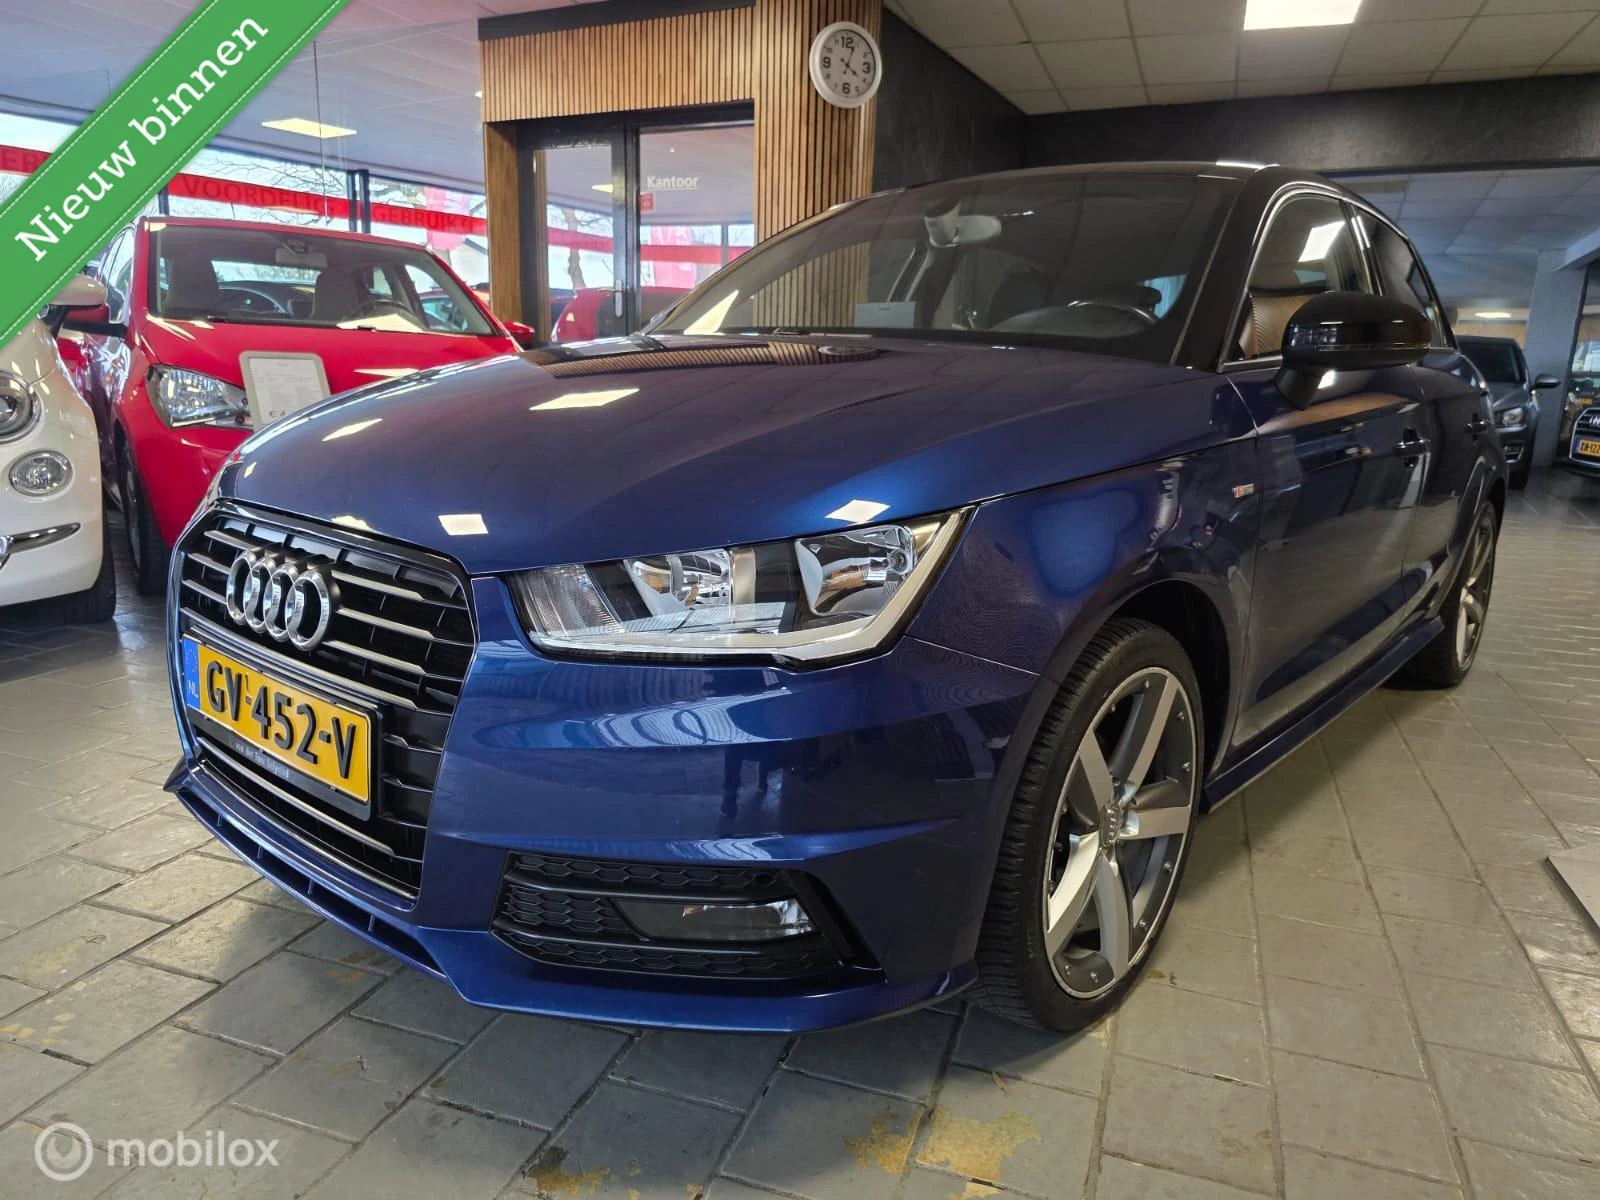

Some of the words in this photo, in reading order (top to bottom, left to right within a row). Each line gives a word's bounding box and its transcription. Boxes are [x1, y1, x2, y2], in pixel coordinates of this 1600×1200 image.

[841, 35, 854, 48] 12
[822, 56, 831, 69] 9
[862, 62, 871, 74] 3
[841, 82, 850, 94] 6
[647, 175, 699, 189] Kantoor
[188, 679, 199, 698] NL
[206, 660, 356, 779] GV-452-V
